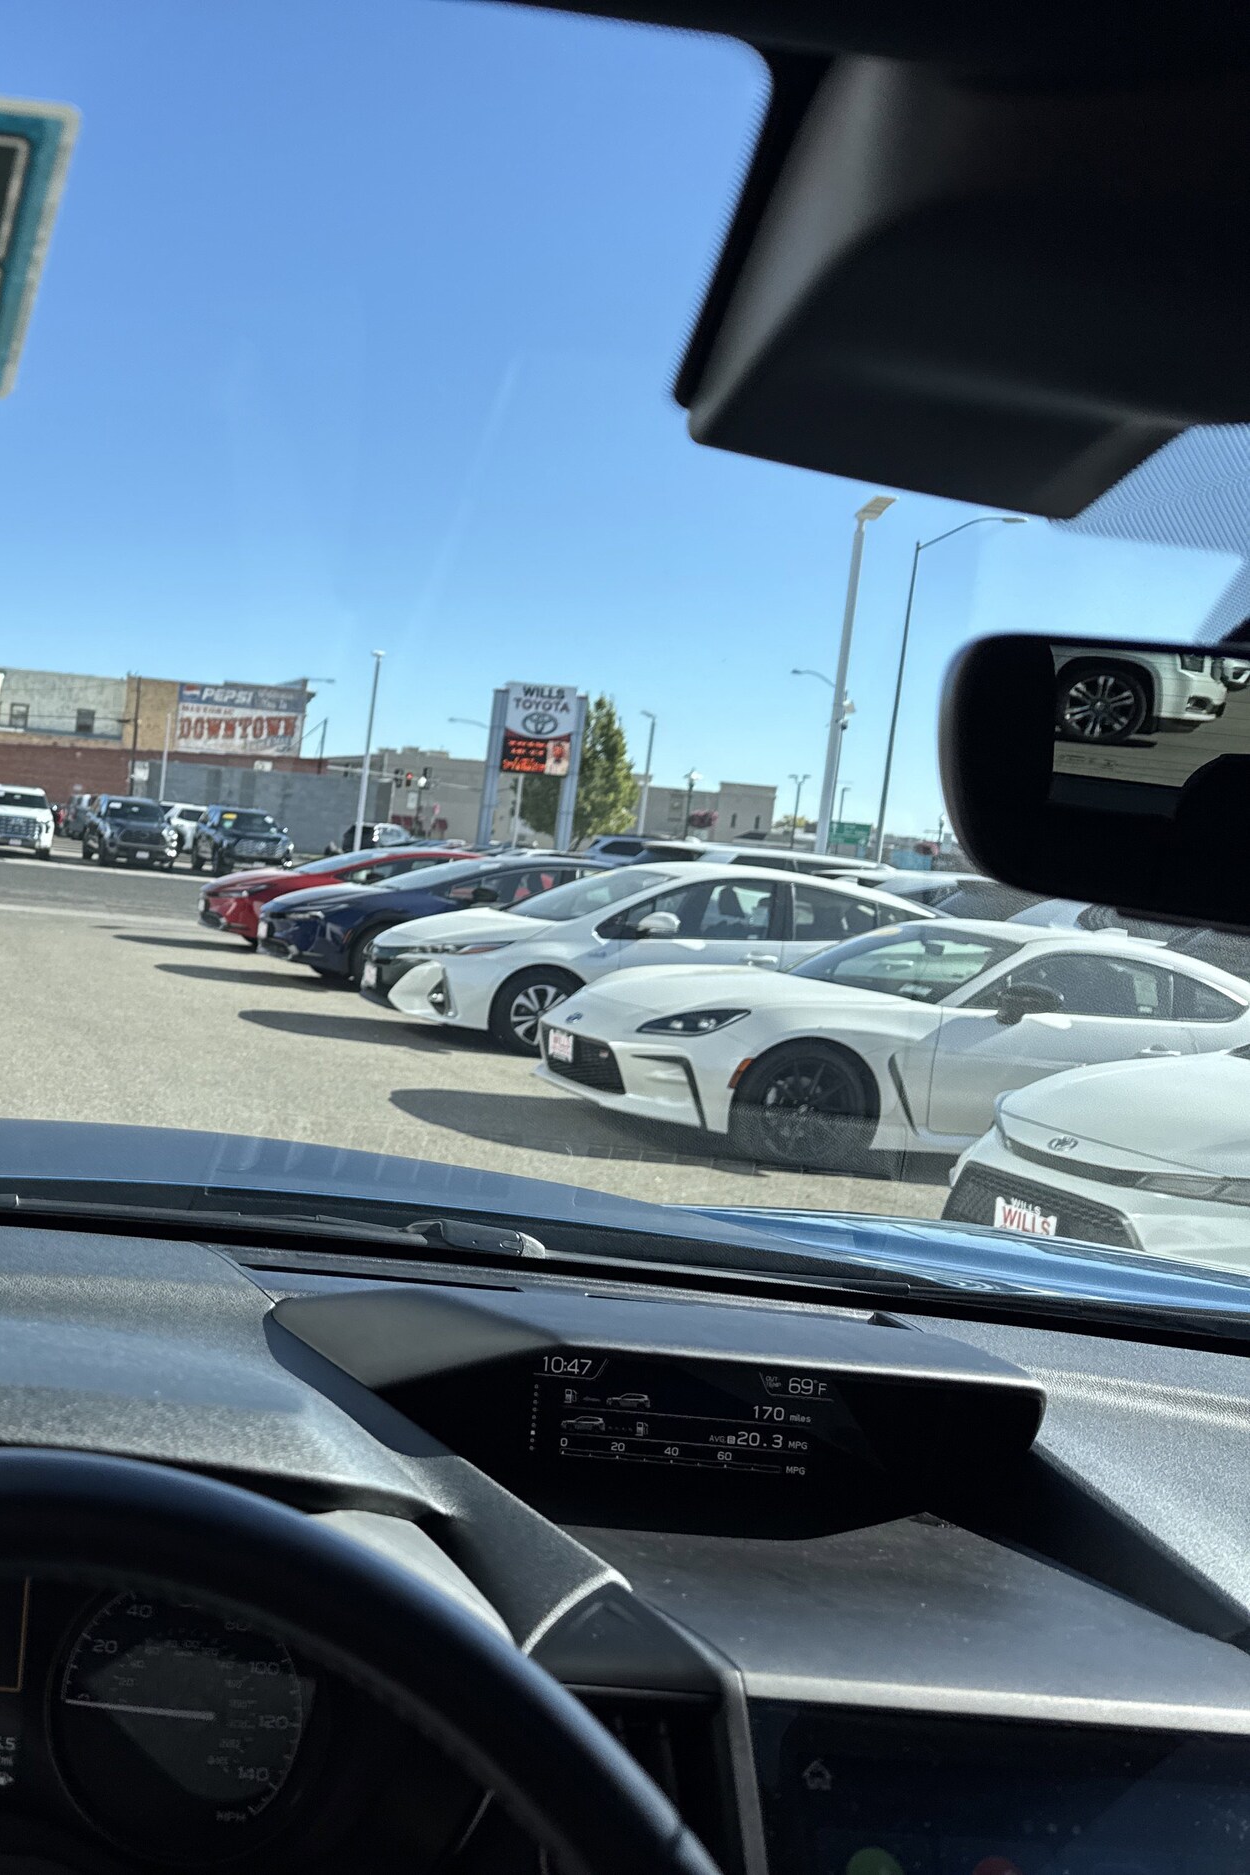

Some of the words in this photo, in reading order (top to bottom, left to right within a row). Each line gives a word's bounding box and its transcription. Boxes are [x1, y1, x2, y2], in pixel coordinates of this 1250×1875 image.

[201, 687, 254, 704] PEPSI
[523, 685, 565, 699] WILLS
[513, 697, 570, 713] TOYOTA
[179, 715, 298, 740] DOWNTOWN
[1011, 1197, 1041, 1214] WILLS
[1003, 1206, 1051, 1236] WILLS
[541, 1355, 593, 1376] 10:47
[753, 1405, 785, 1421] 170
[789, 1414, 812, 1423] miles
[559, 1437, 568, 1447] 0
[610, 1441, 626, 1452] 20
[664, 1446, 680, 1457] 40
[717, 1451, 733, 1461] 60
[737, 1431, 784, 1448] 20.3
[787, 1440, 809, 1450] MPG
[785, 1465, 806, 1476] MPG
[126, 1604, 153, 1619] 40
[92, 1639, 118, 1654] 20
[250, 1660, 280, 1676] 100
[257, 1715, 289, 1731] 120
